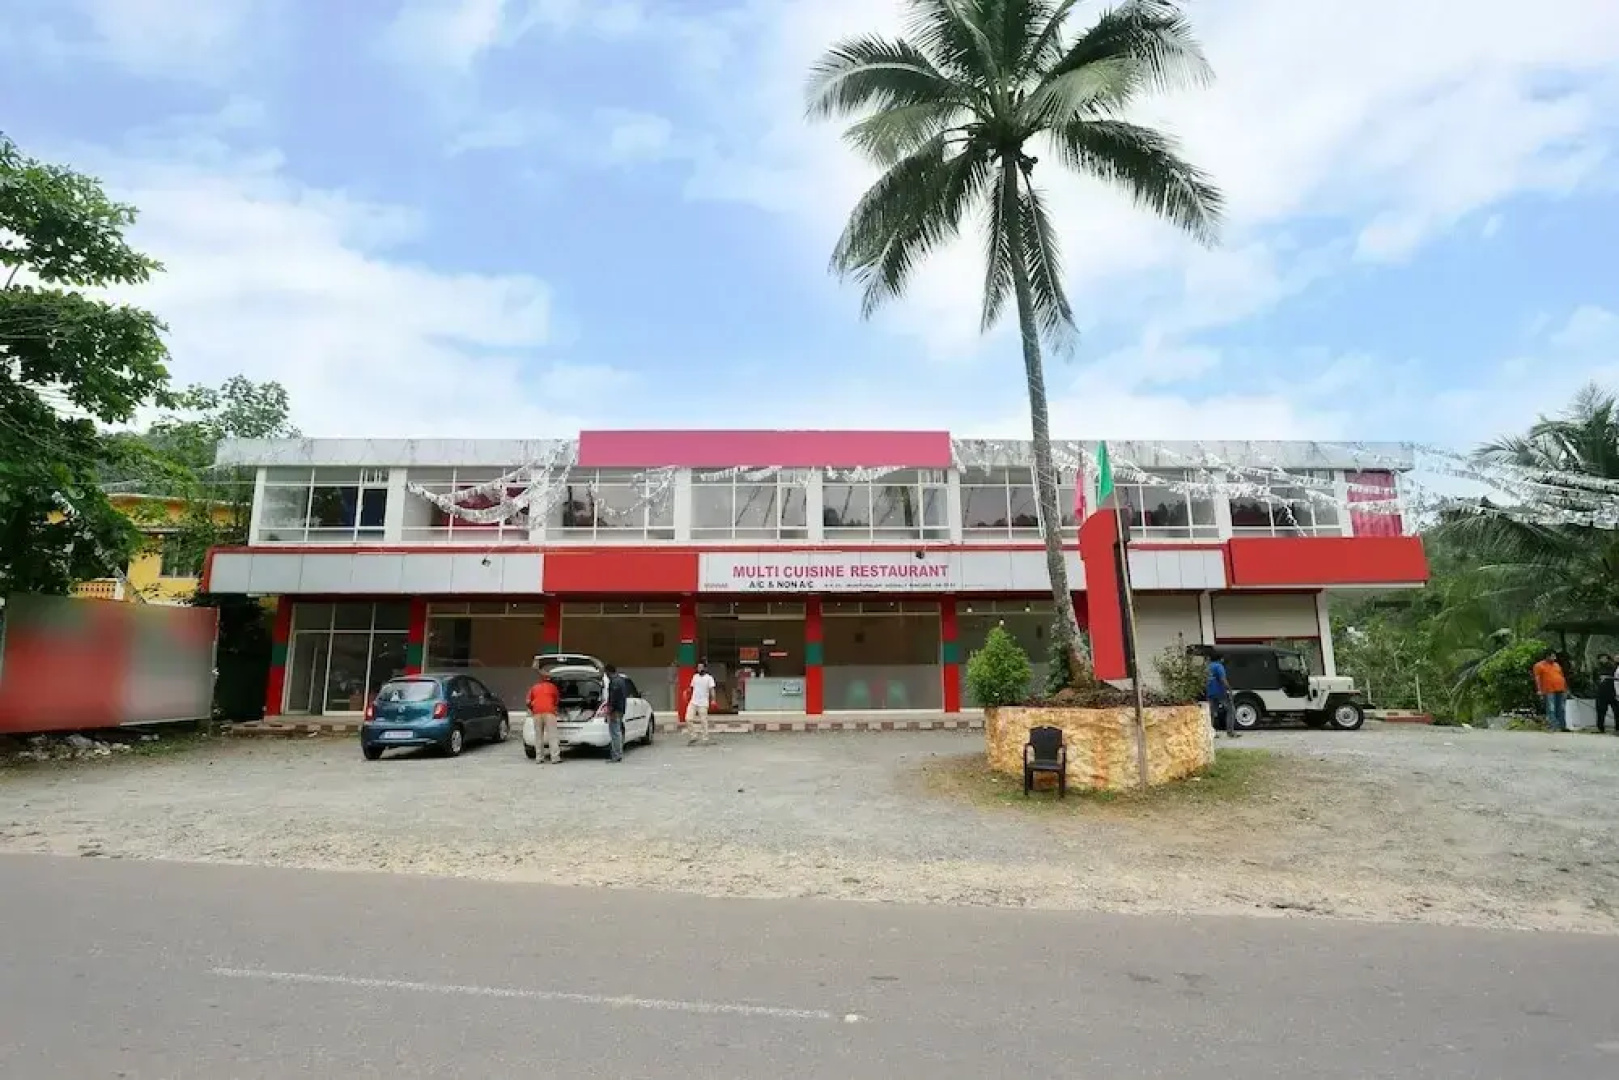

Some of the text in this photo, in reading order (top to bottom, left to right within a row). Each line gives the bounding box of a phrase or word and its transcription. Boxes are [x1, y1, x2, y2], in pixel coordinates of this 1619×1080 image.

[732, 565, 949, 578] MULTI CUISINE RESTAURANT
